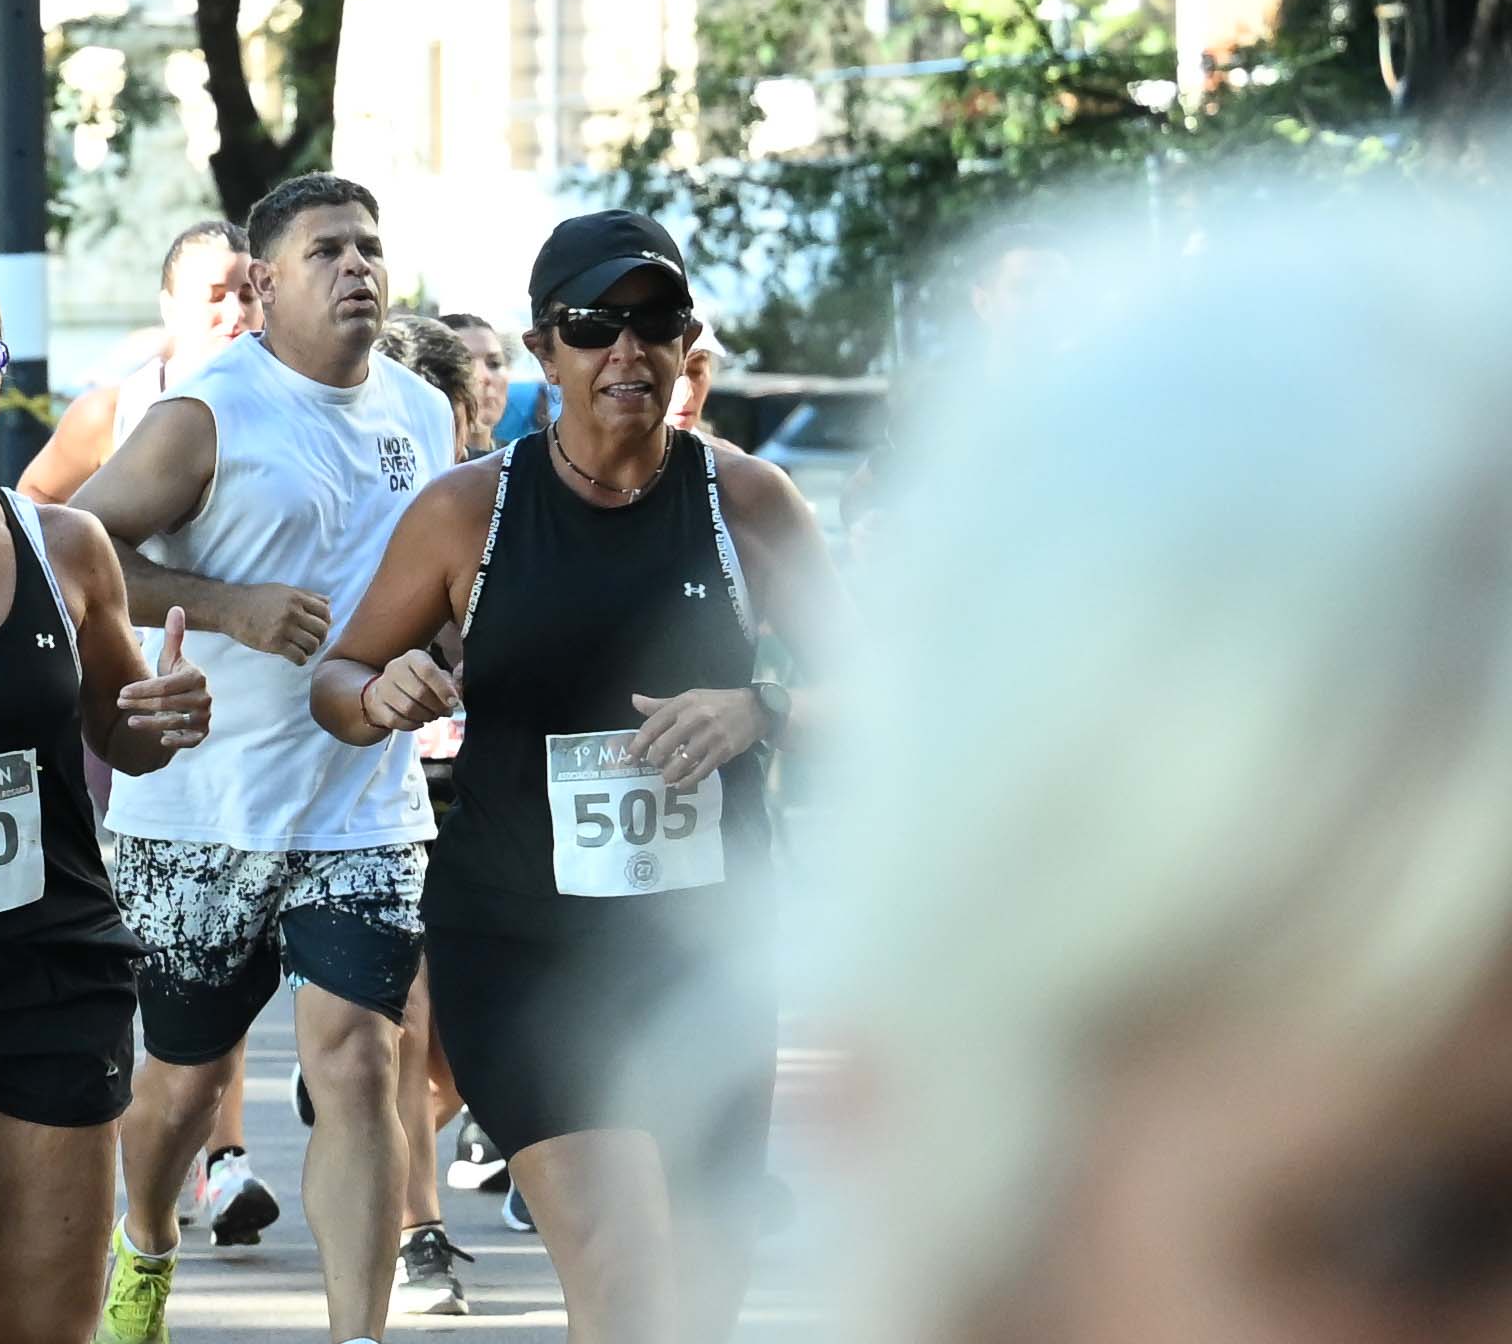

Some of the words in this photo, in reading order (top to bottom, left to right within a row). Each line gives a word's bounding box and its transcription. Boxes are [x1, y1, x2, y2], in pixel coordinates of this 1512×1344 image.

[380, 455, 417, 474] EVERY
[389, 472, 414, 492] DAY
[480, 509, 502, 566] ARMOUR
[574, 783, 699, 848] 505
